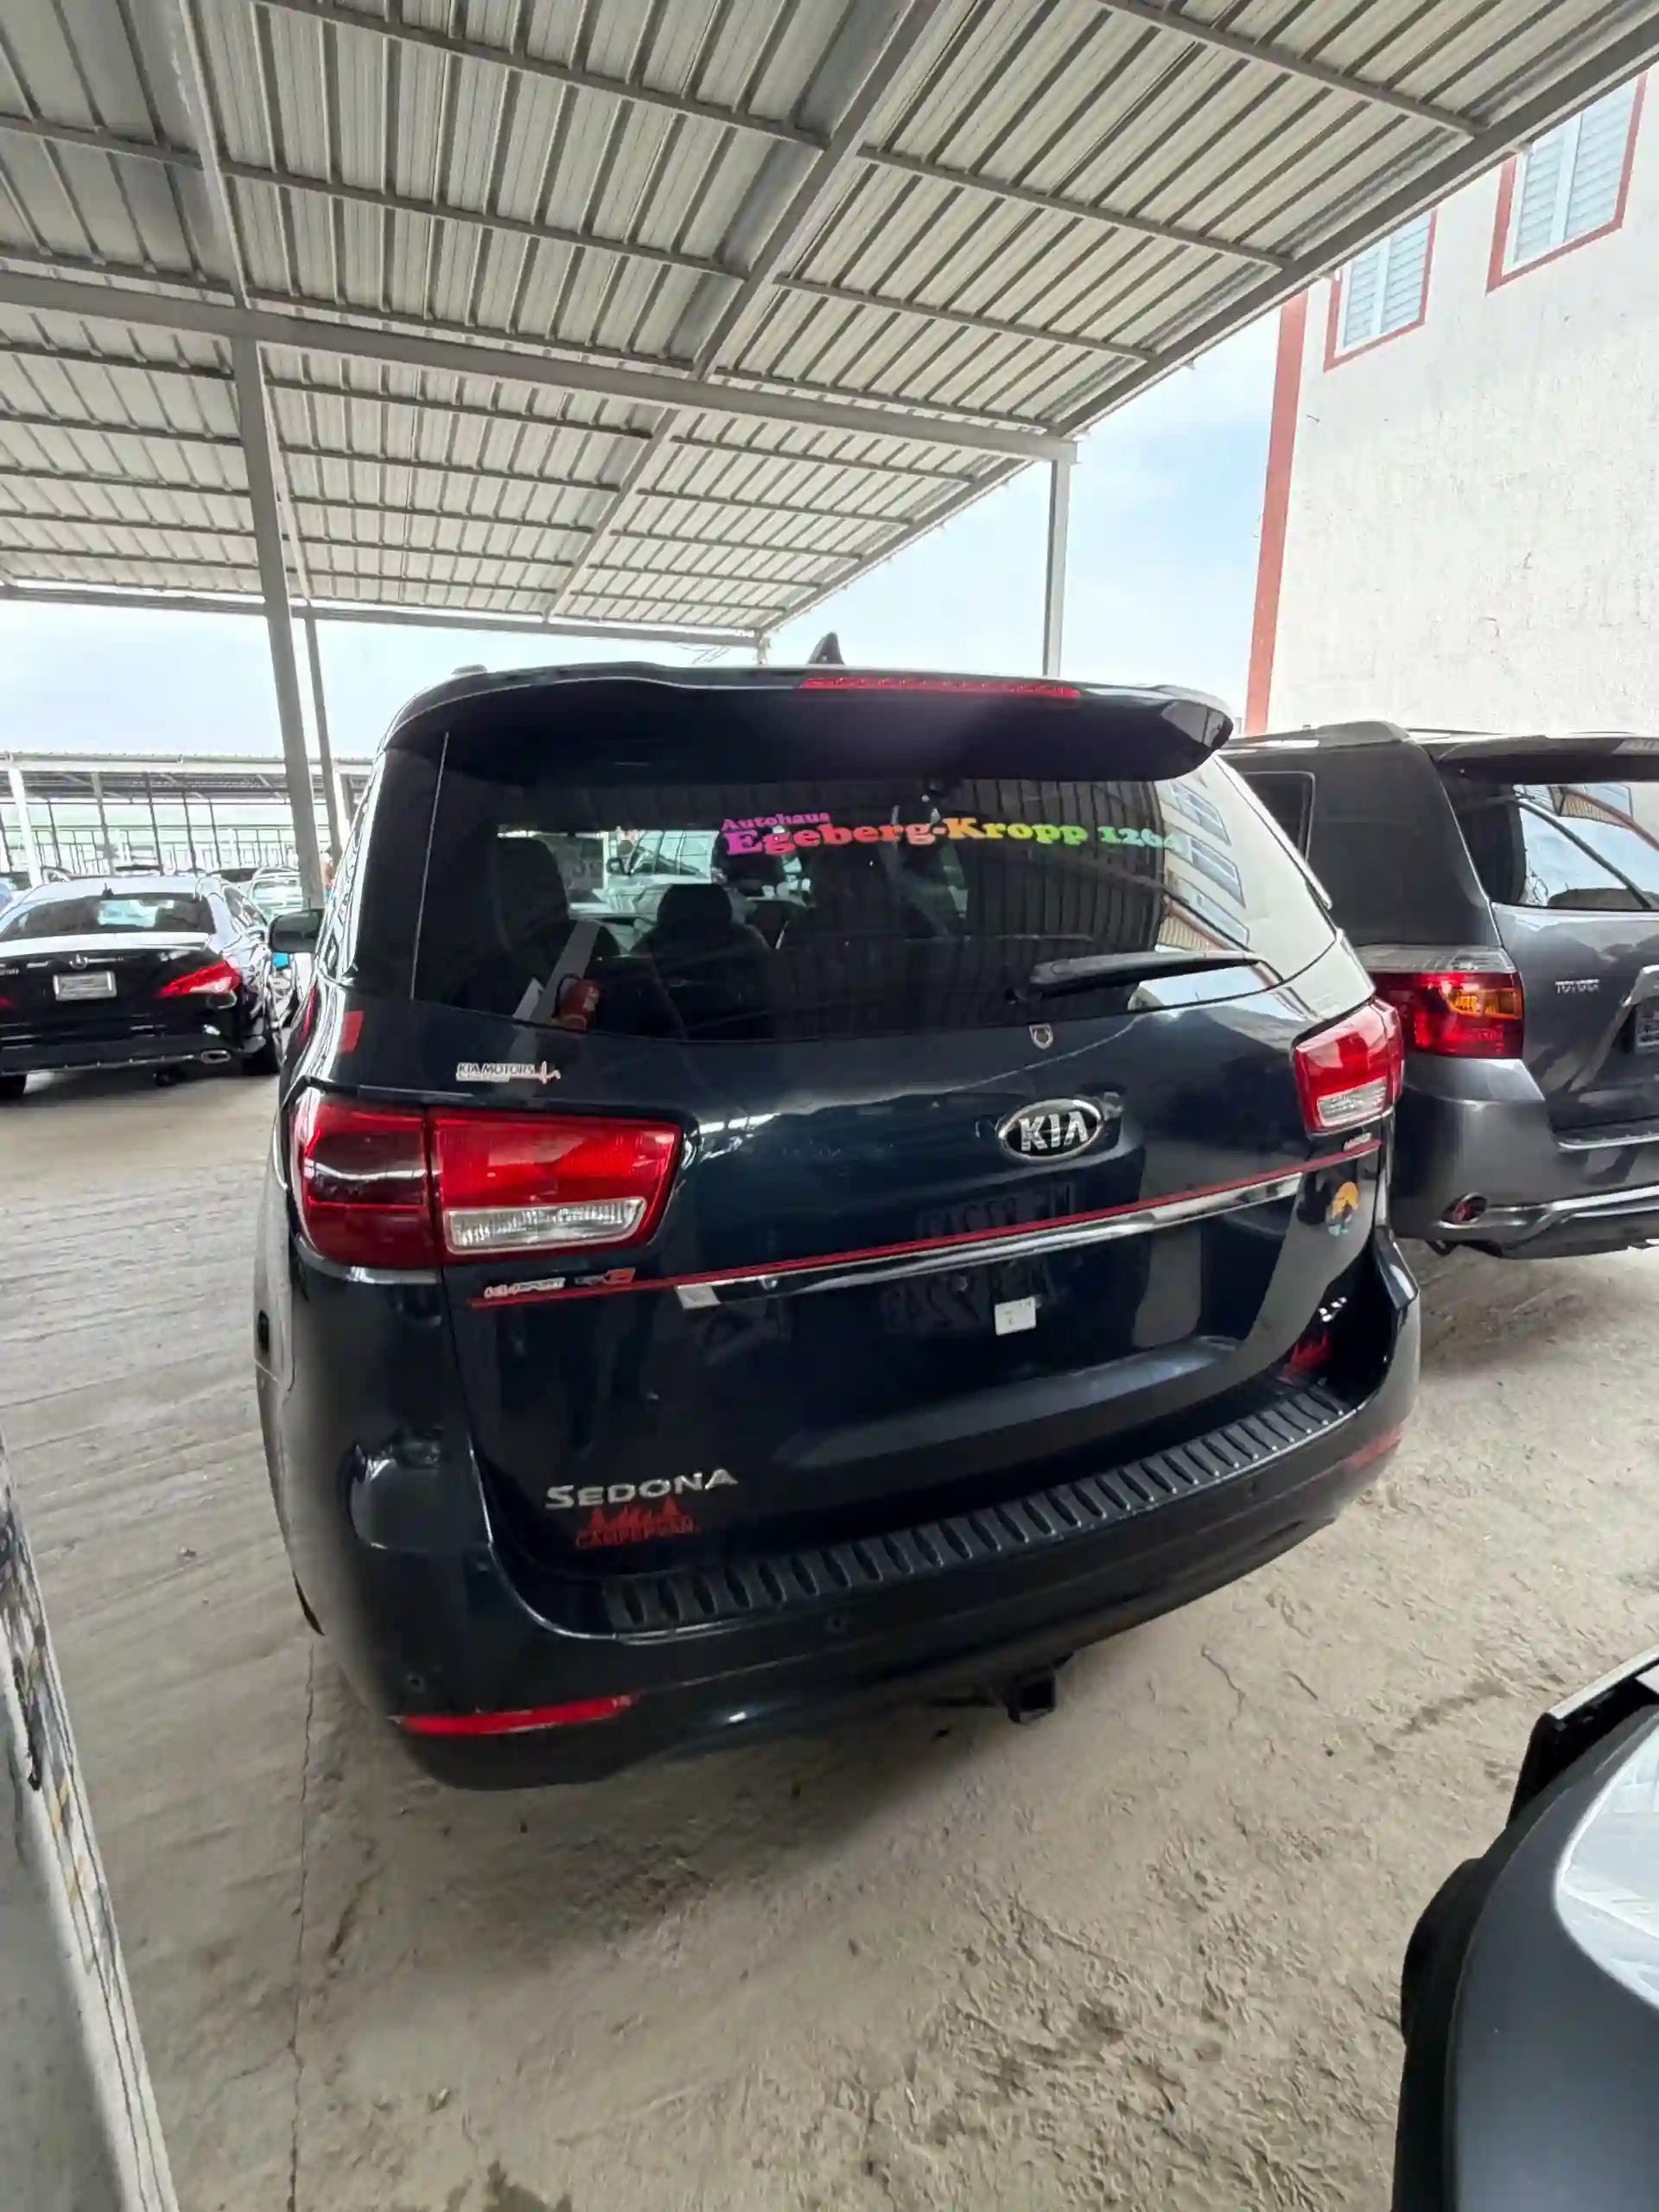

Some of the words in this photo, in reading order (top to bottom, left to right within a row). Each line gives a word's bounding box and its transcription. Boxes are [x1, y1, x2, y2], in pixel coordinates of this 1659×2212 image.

[721, 812, 830, 831] Autohaus
[724, 817, 1089, 855] Egeberg-Kropp
[1019, 1110, 1090, 1152] KIA
[544, 1468, 740, 1510] SEDONA
